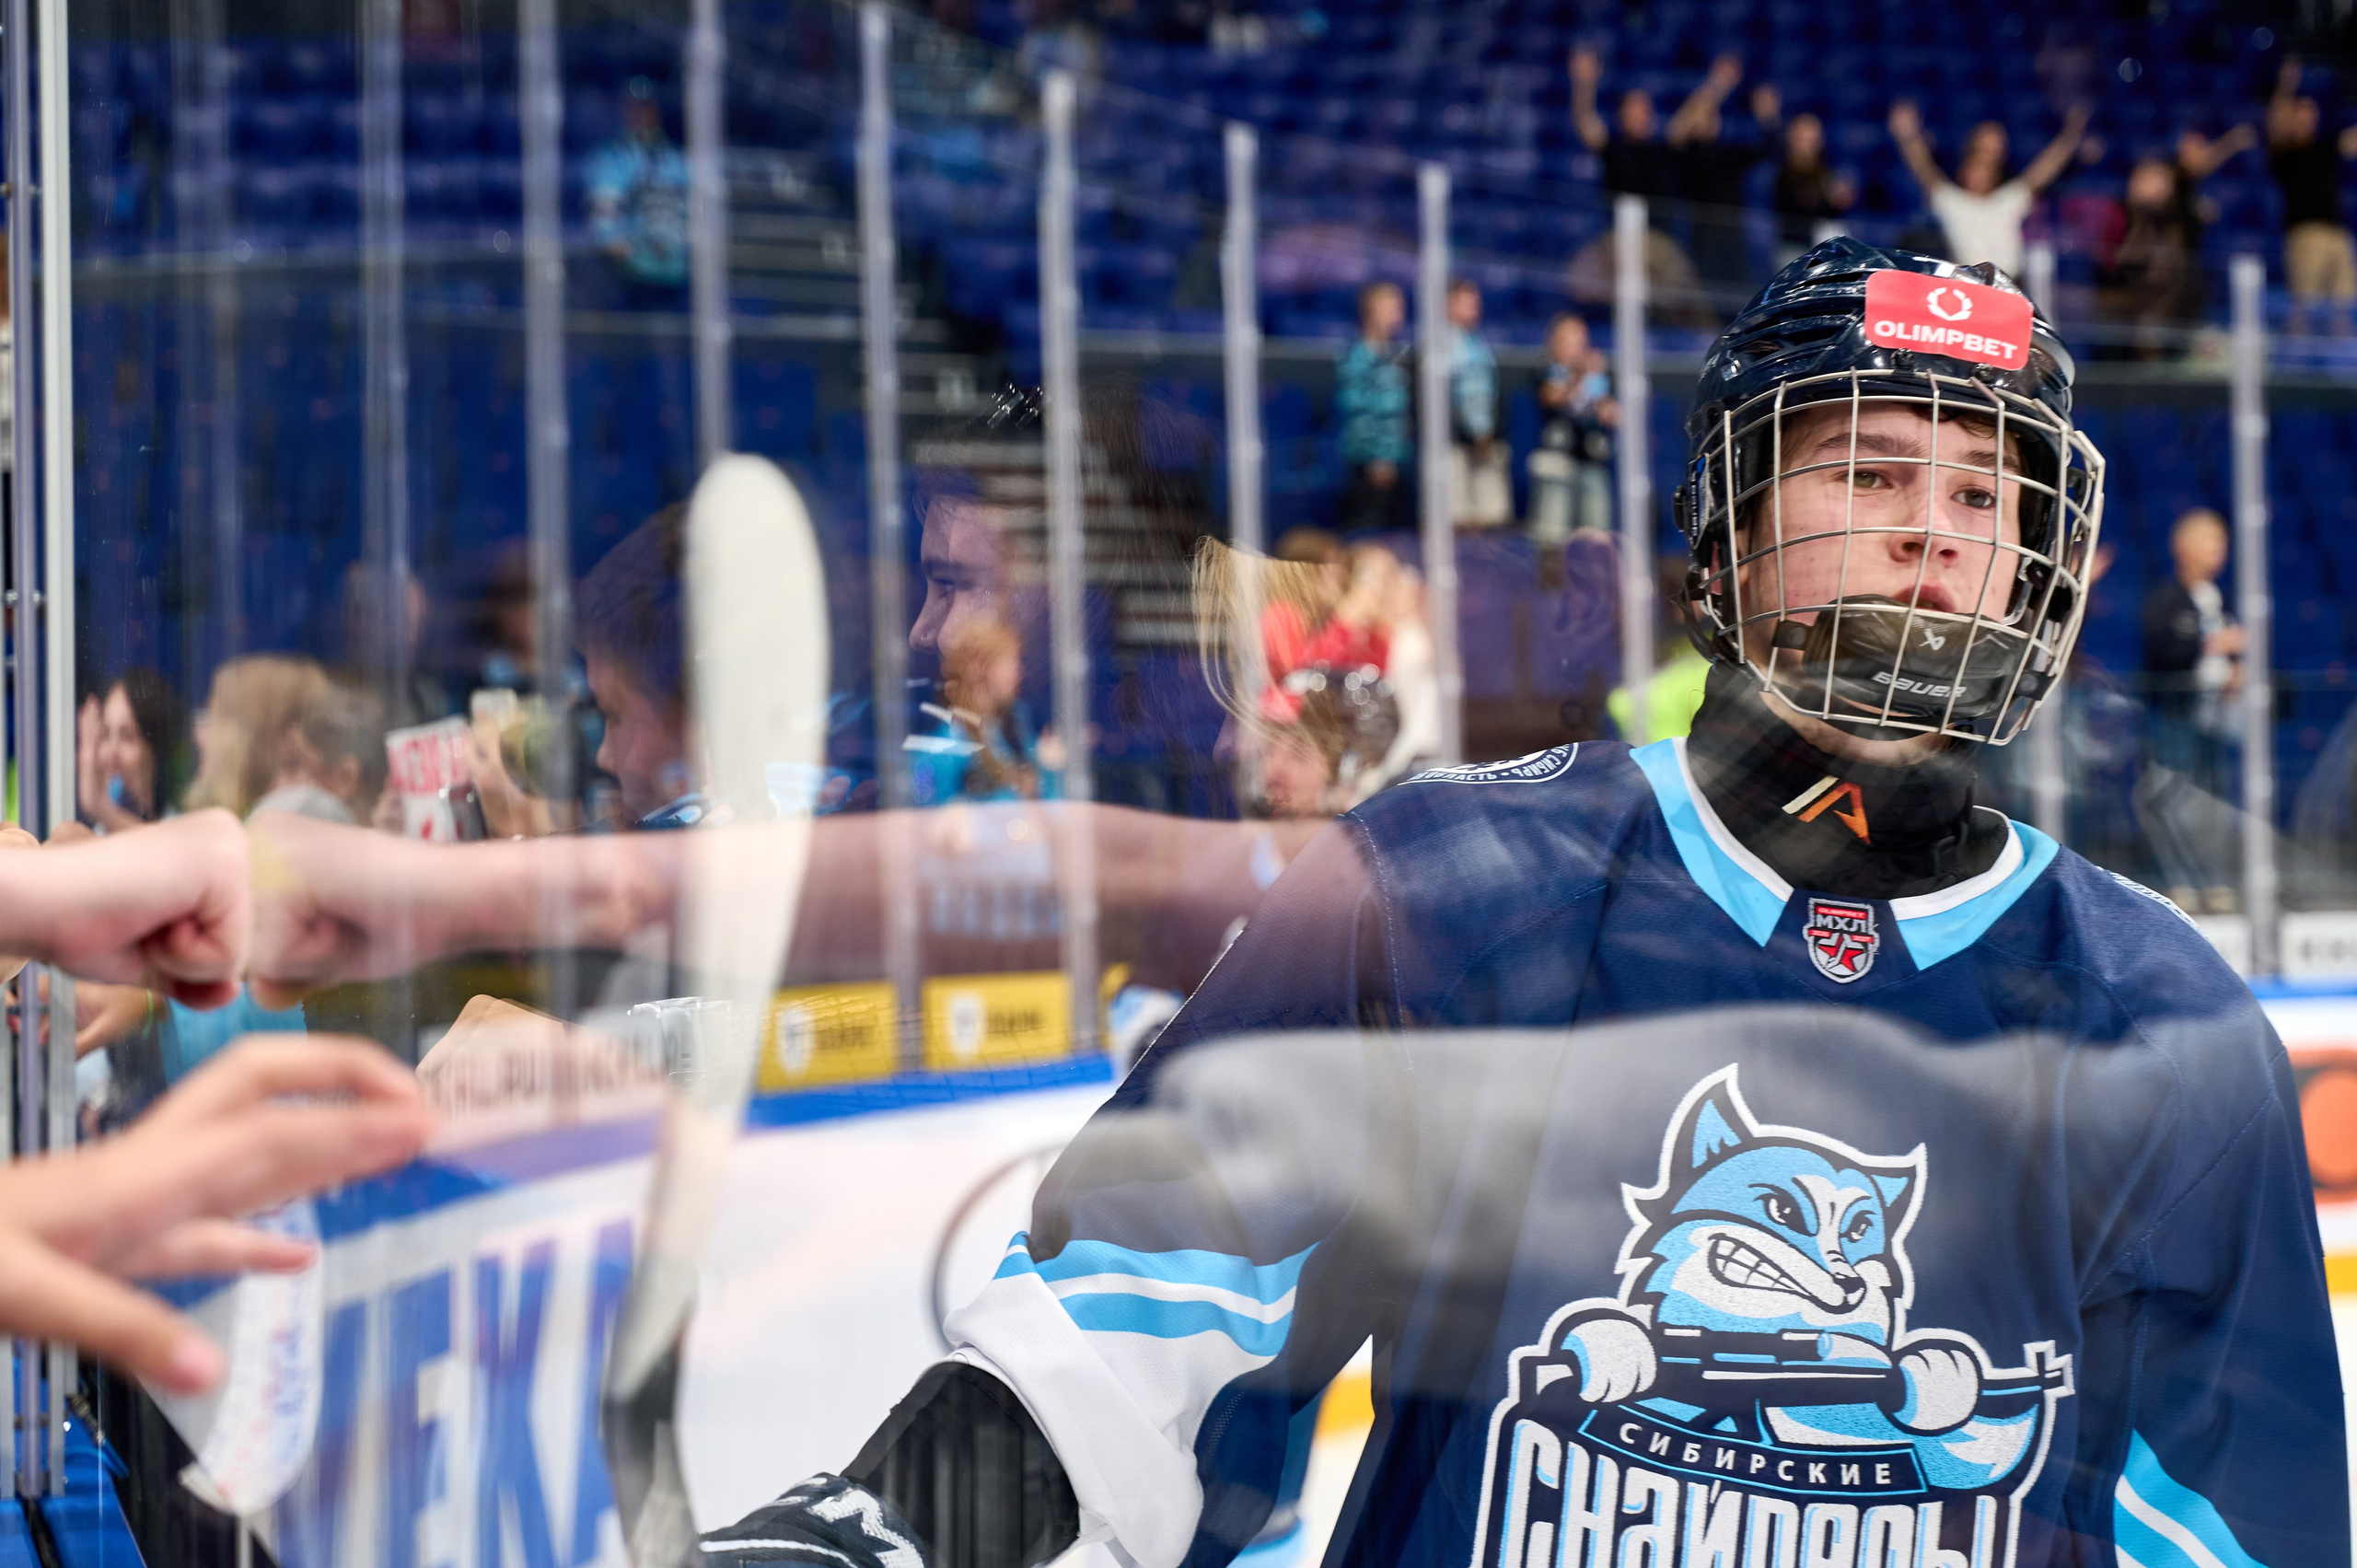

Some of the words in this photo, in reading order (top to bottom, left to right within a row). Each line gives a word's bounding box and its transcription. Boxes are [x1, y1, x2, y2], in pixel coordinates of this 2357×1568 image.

[1873, 319, 2018, 360] OLIMPBET
[1871, 671, 1967, 698] BAUER
[1816, 913, 1866, 934] МХЛ
[1618, 1422, 1893, 1485] СИБИРСКИЕ
